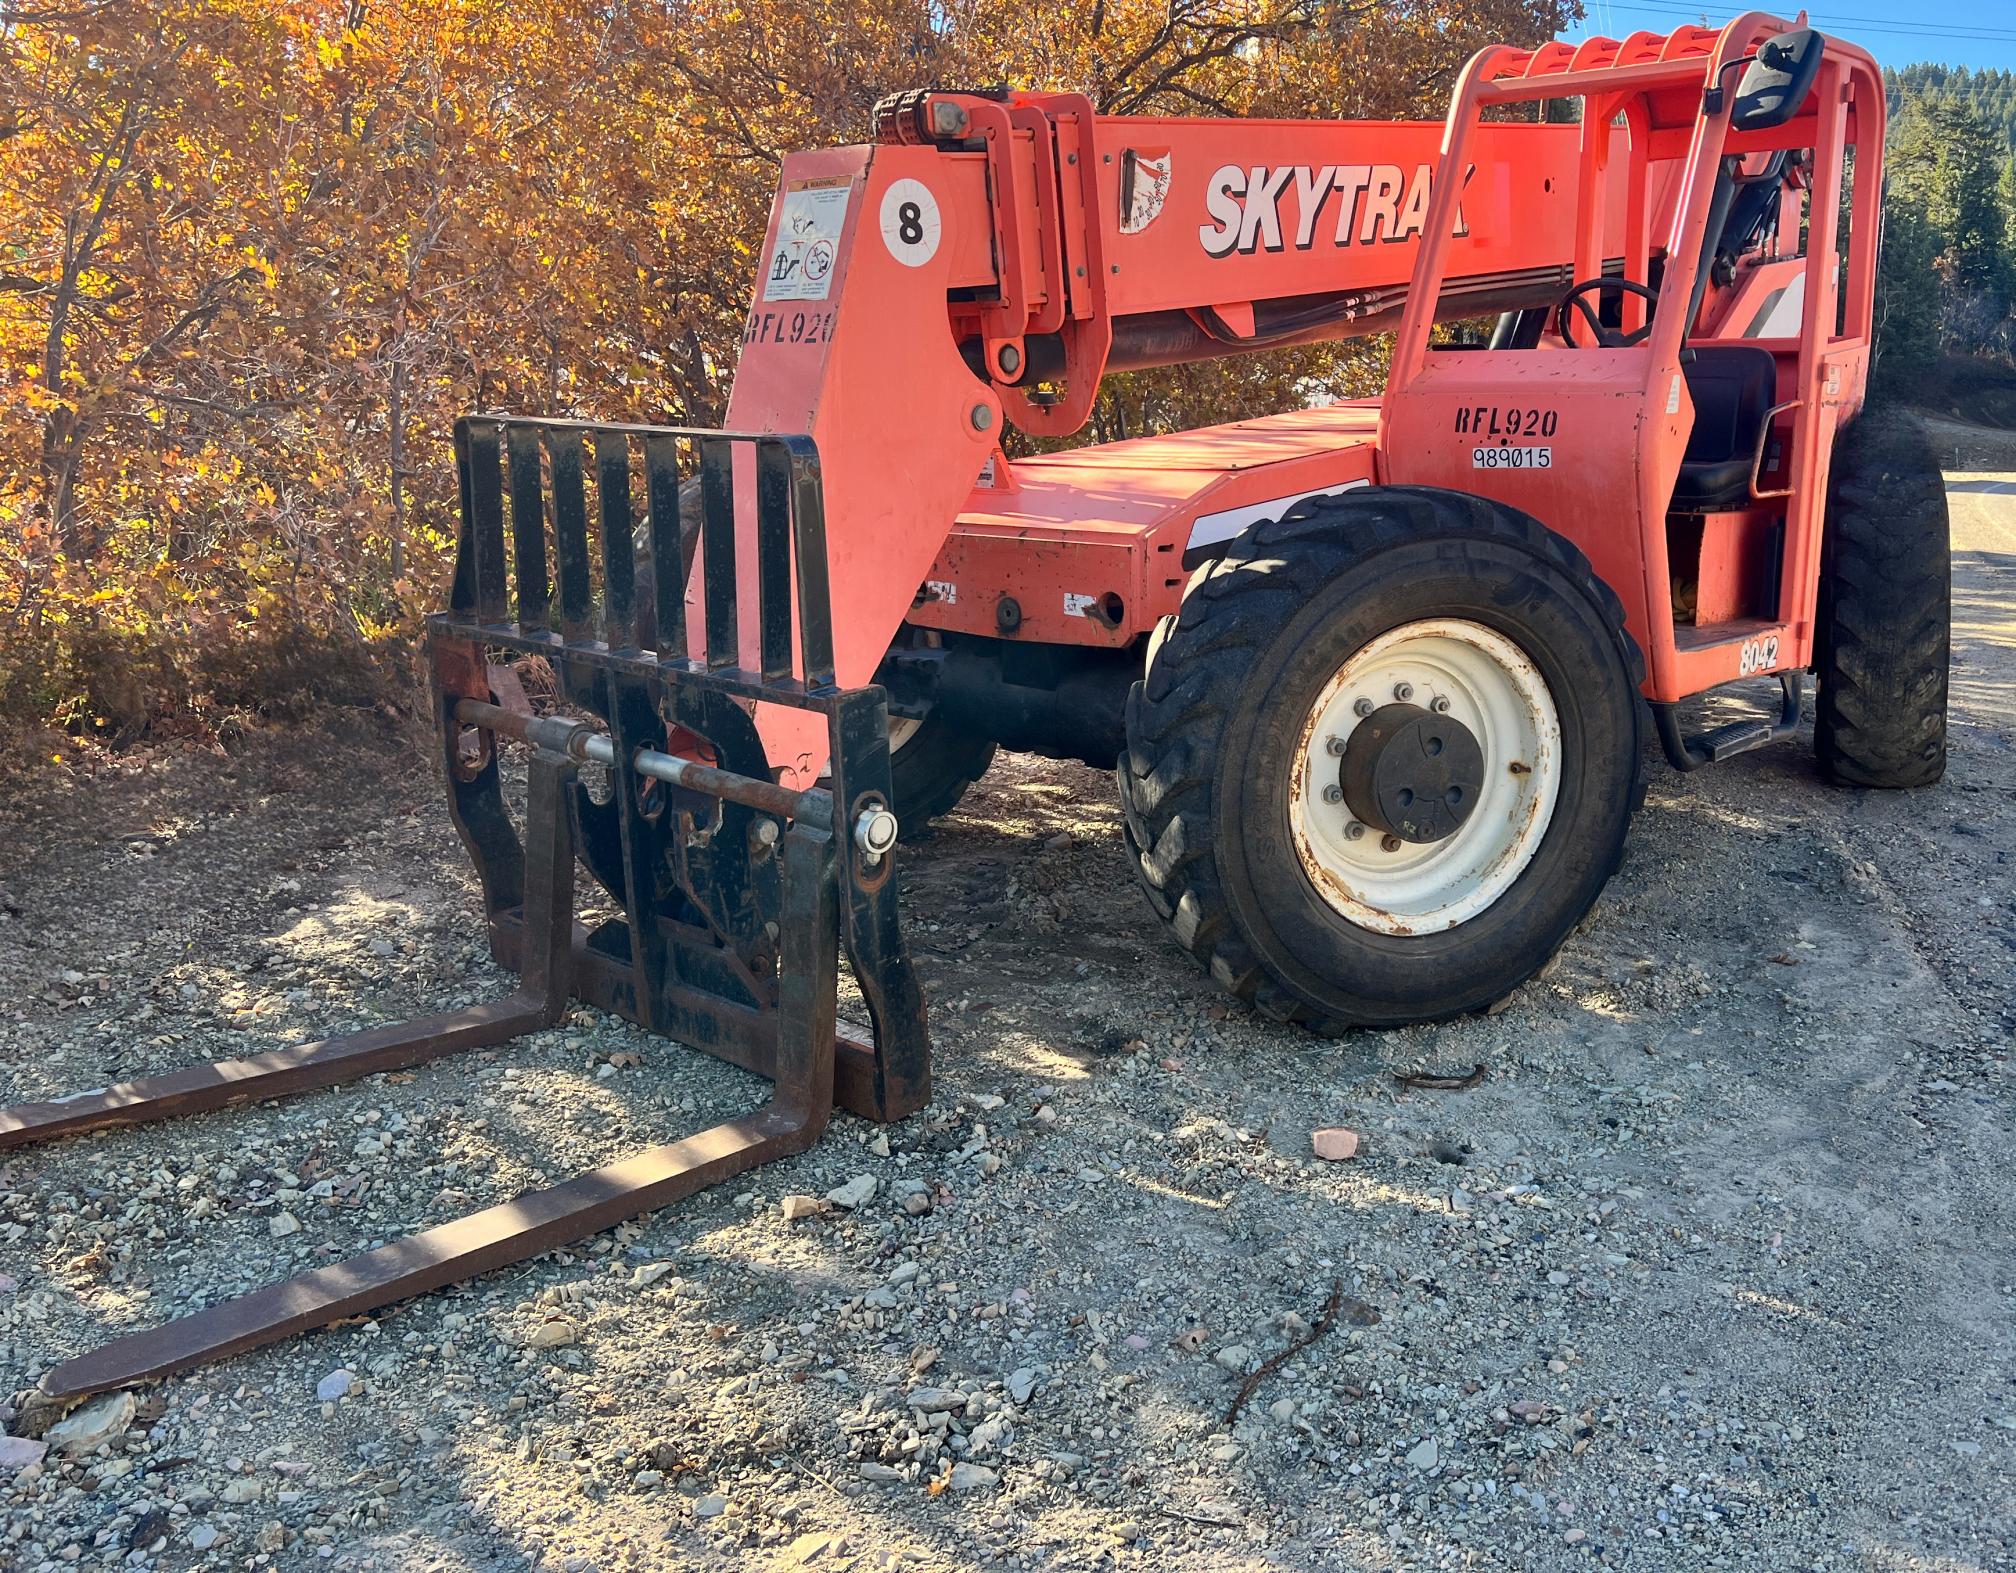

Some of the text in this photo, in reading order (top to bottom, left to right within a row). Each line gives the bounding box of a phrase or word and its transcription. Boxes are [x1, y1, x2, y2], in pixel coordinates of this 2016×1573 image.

[899, 201, 923, 245] 8
[1455, 407, 1558, 437] RFL920
[1474, 448, 1550, 468] 989015
[1740, 636, 1779, 676] 8042
